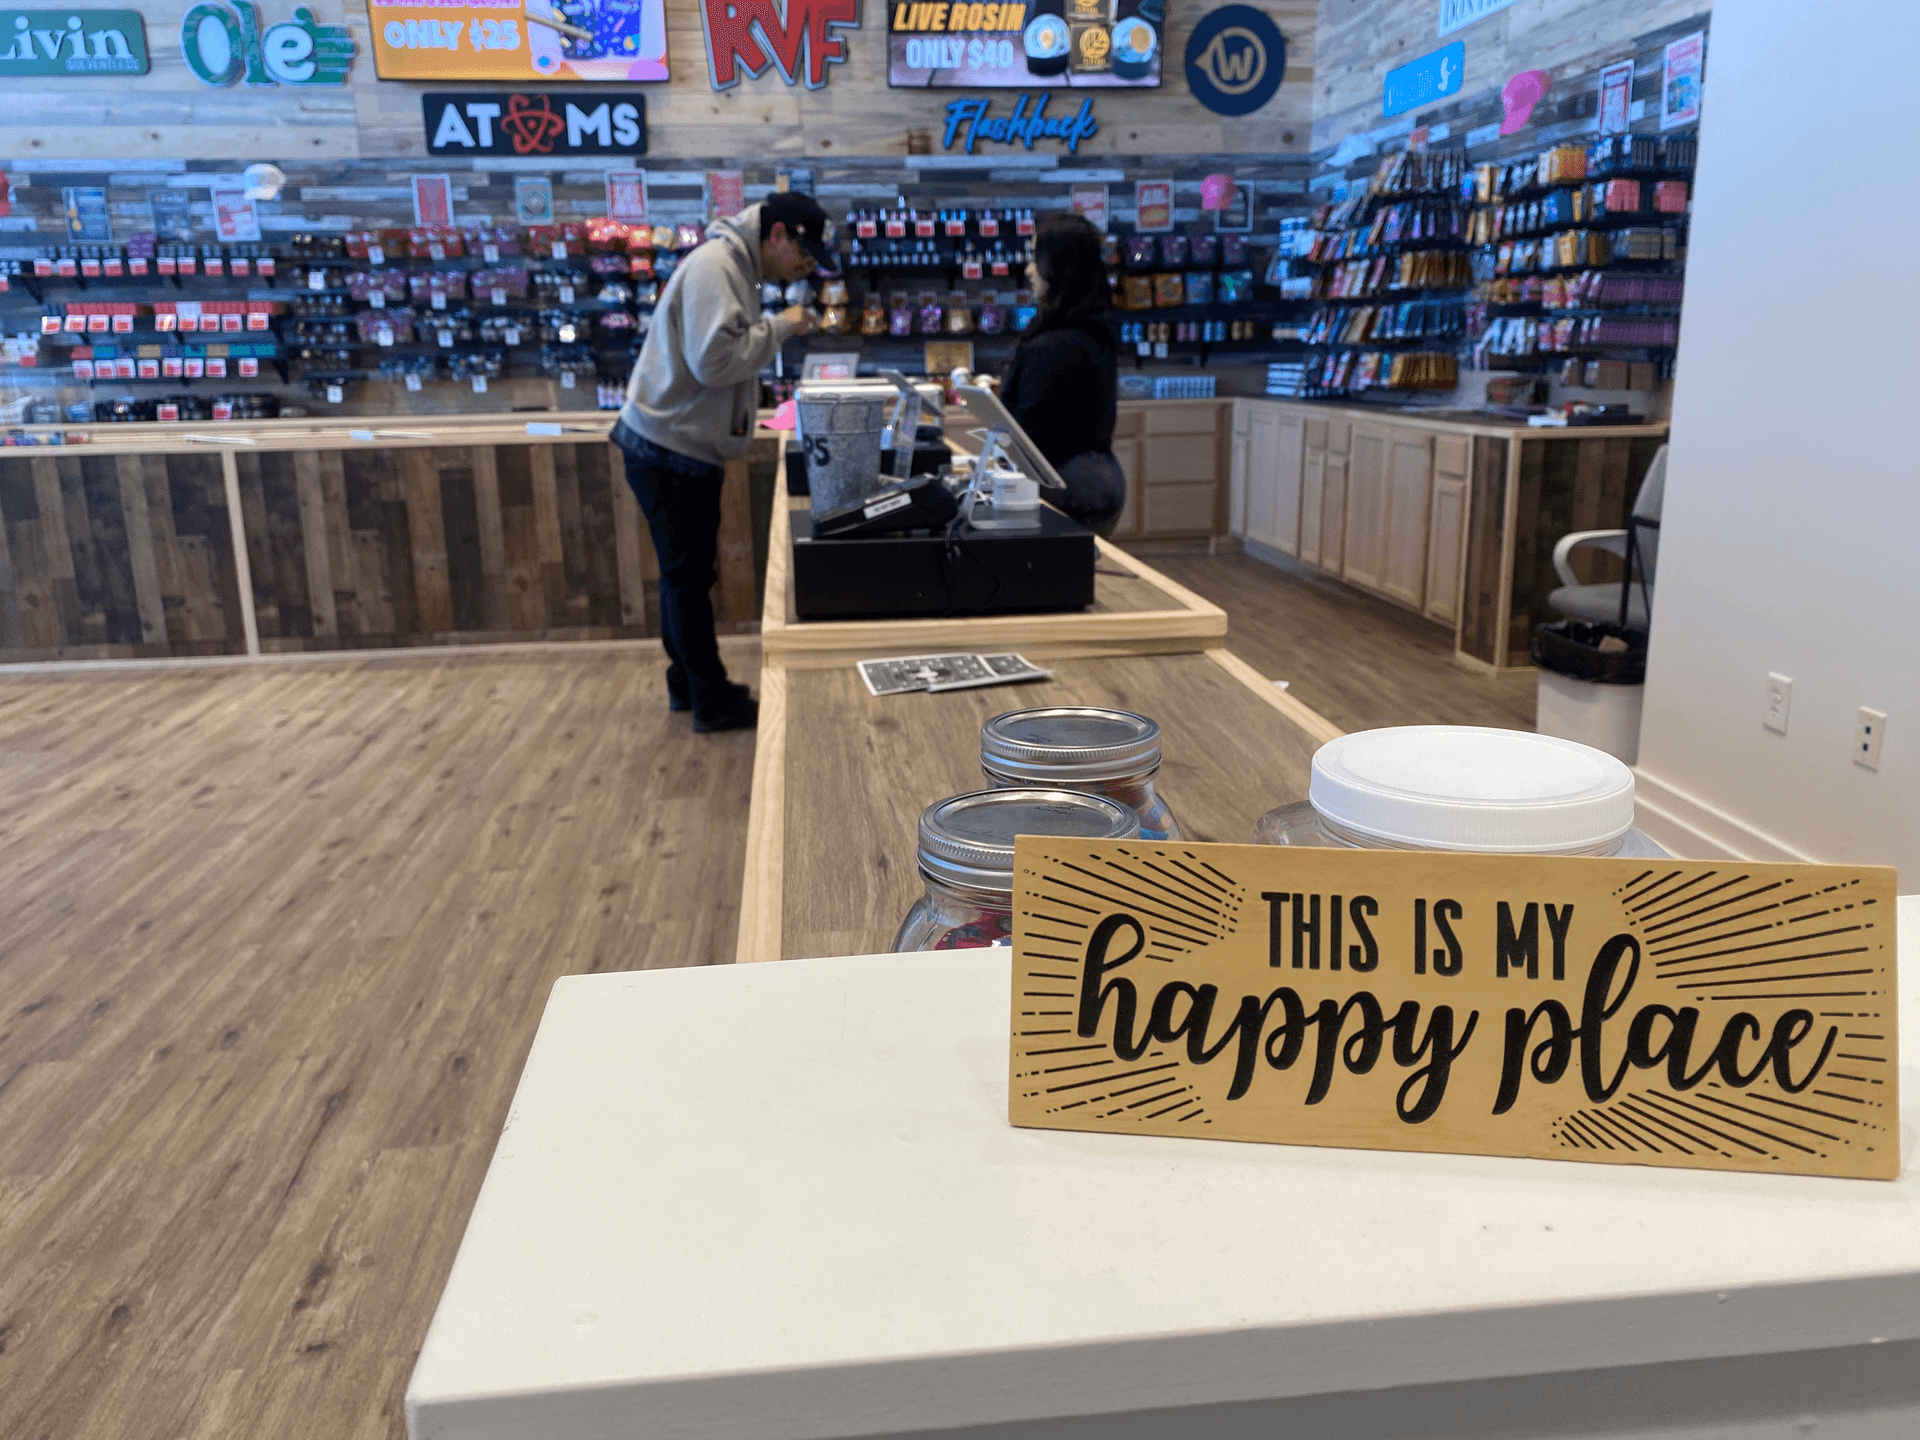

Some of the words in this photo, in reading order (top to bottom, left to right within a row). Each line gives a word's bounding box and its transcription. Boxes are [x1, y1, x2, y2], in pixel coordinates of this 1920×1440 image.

[384, 19, 465, 51] ONLY
[469, 18, 521, 52] $25
[699, 0, 862, 92] RVF
[893, 3, 949, 31] LIVE
[948, 3, 1026, 31] ROSIN
[906, 38, 966, 69] ONLY
[967, 38, 1014, 70] $40
[943, 92, 1098, 152] Flashback
[1261, 892, 1379, 973] THIS
[1414, 898, 1463, 977] IS
[1496, 902, 1575, 980] MY
[1078, 914, 1480, 1124] happy
[1492, 934, 1838, 1115] place
